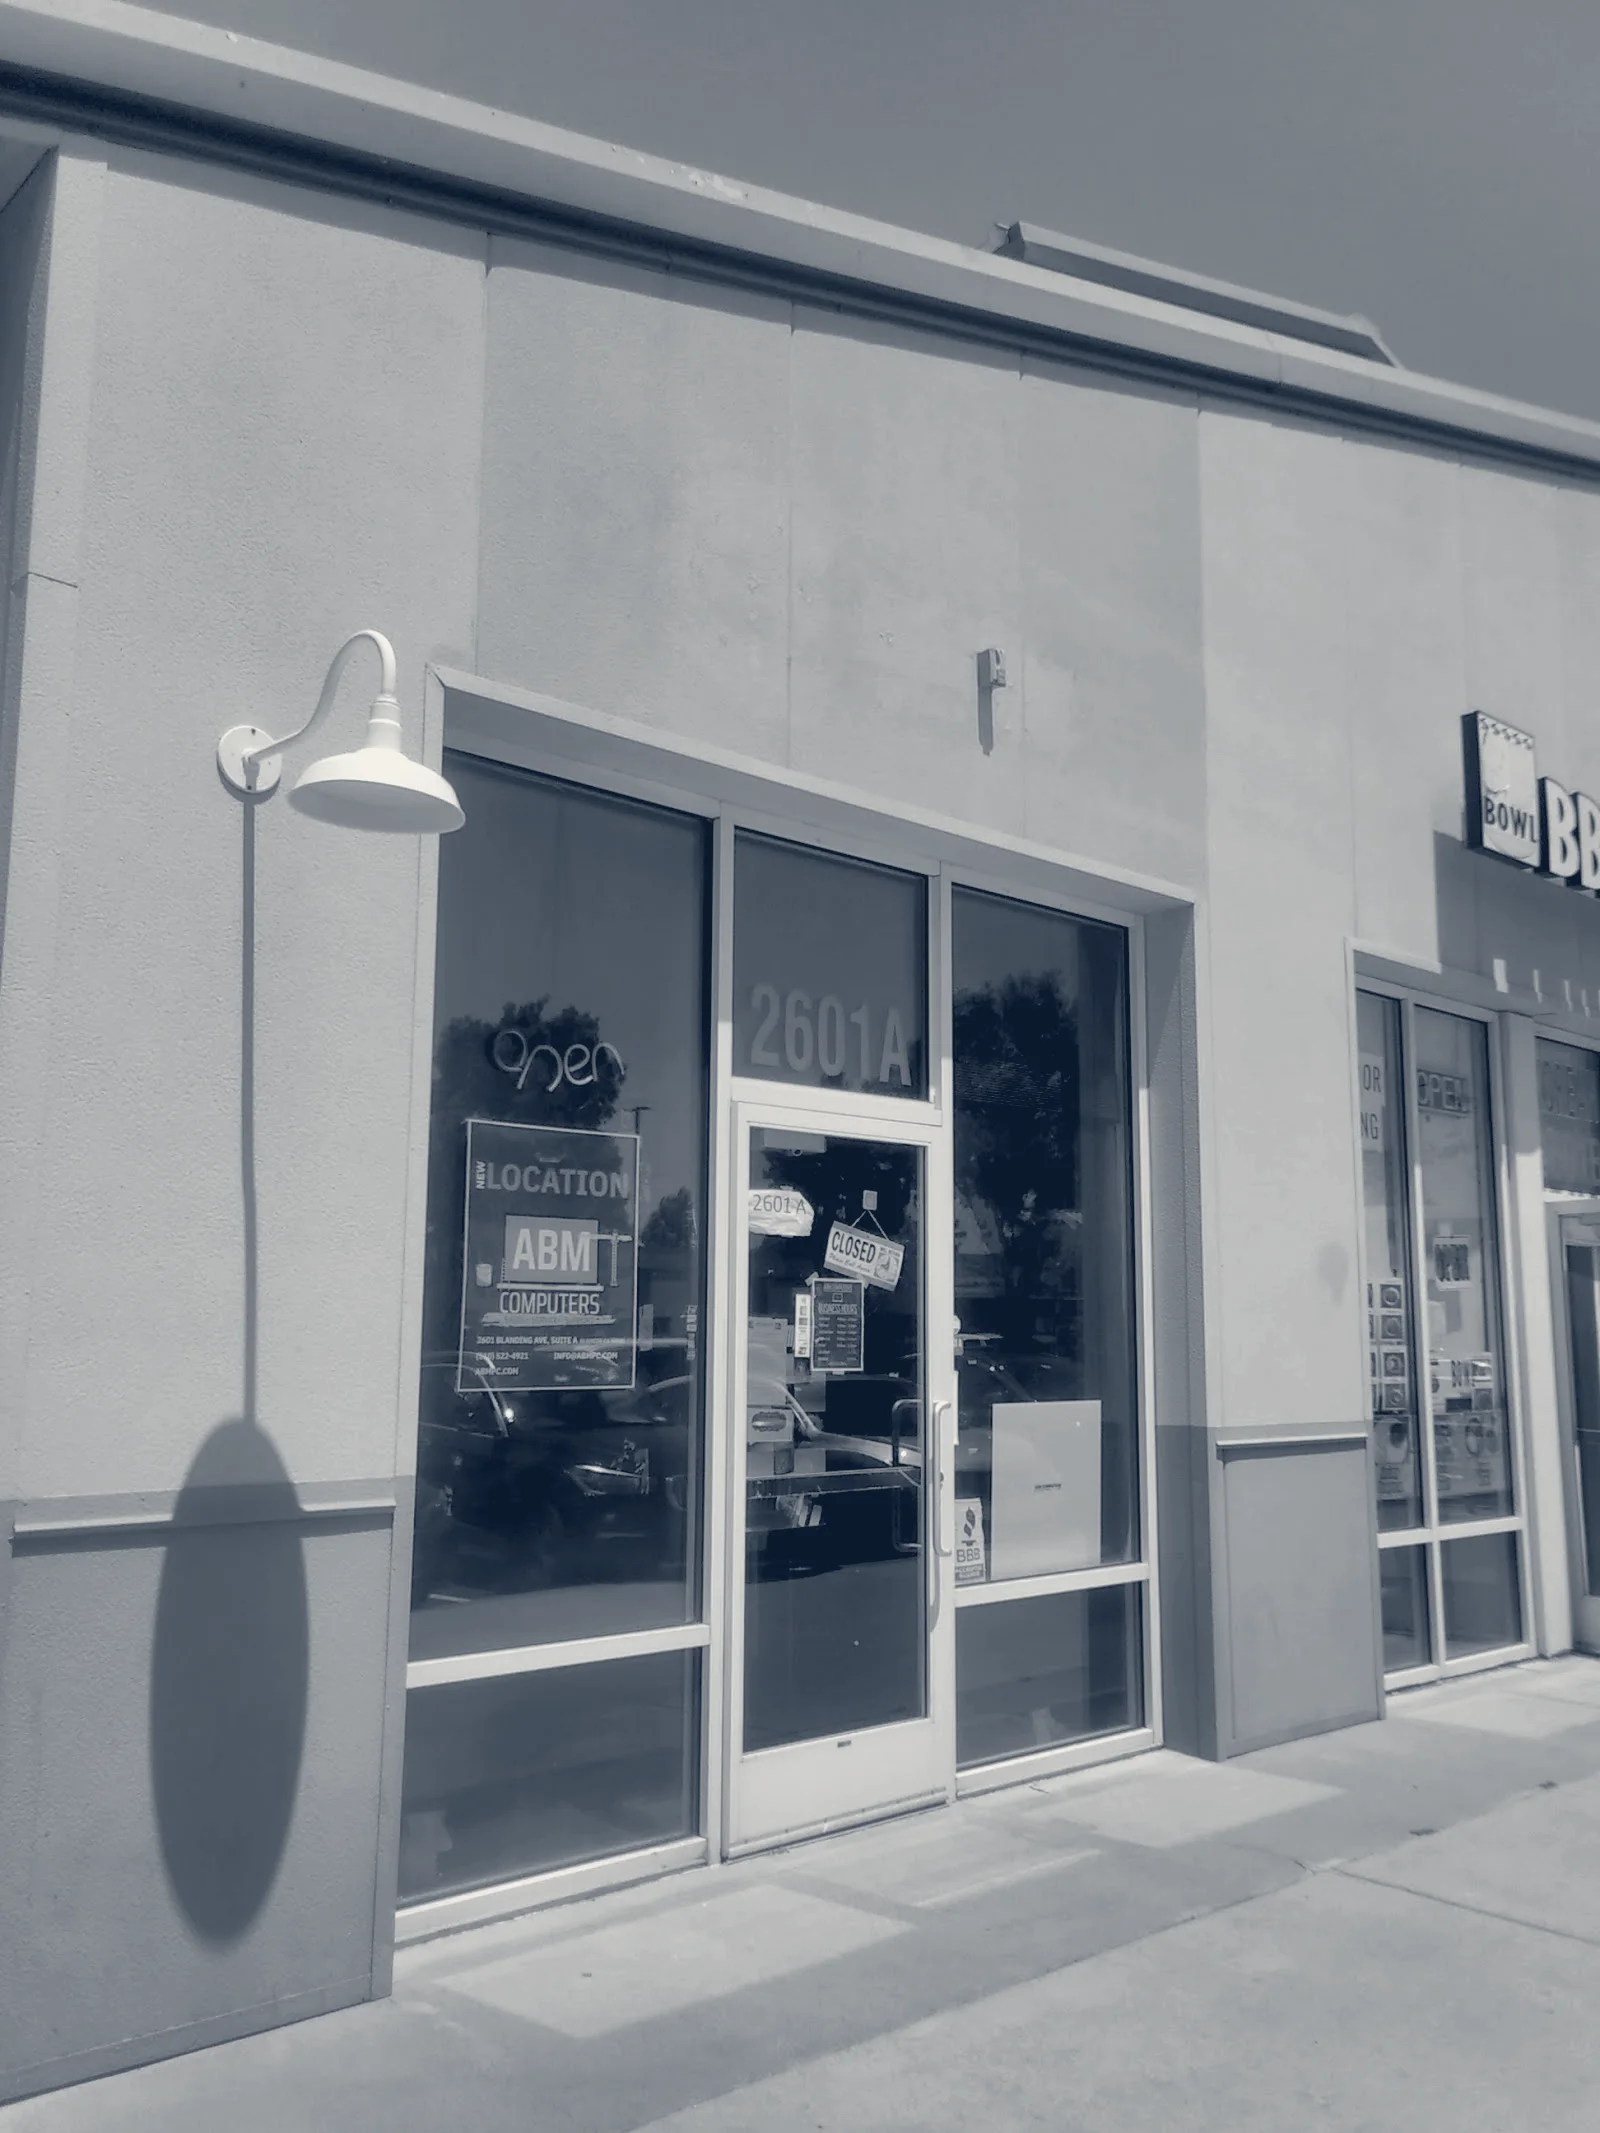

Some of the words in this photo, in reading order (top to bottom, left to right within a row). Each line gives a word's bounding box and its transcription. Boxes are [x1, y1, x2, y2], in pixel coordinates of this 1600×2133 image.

[1483, 794, 1538, 844] BOWL
[475, 1160, 487, 1190] NEW
[487, 1162, 629, 1199] LOCATION
[752, 1193, 792, 1214] 2601
[512, 1227, 592, 1272] ABM
[831, 1230, 877, 1264] CLOSED
[500, 1290, 600, 1315] COMPUTERS
[476, 1336, 495, 1345] 2601
[496, 1336, 533, 1345] BLANDING
[550, 1336, 572, 1345] SUITE
[572, 1336, 579, 1345] A
[495, 1352, 530, 1360] 522-4921
[956, 1548, 981, 1563] BBB
